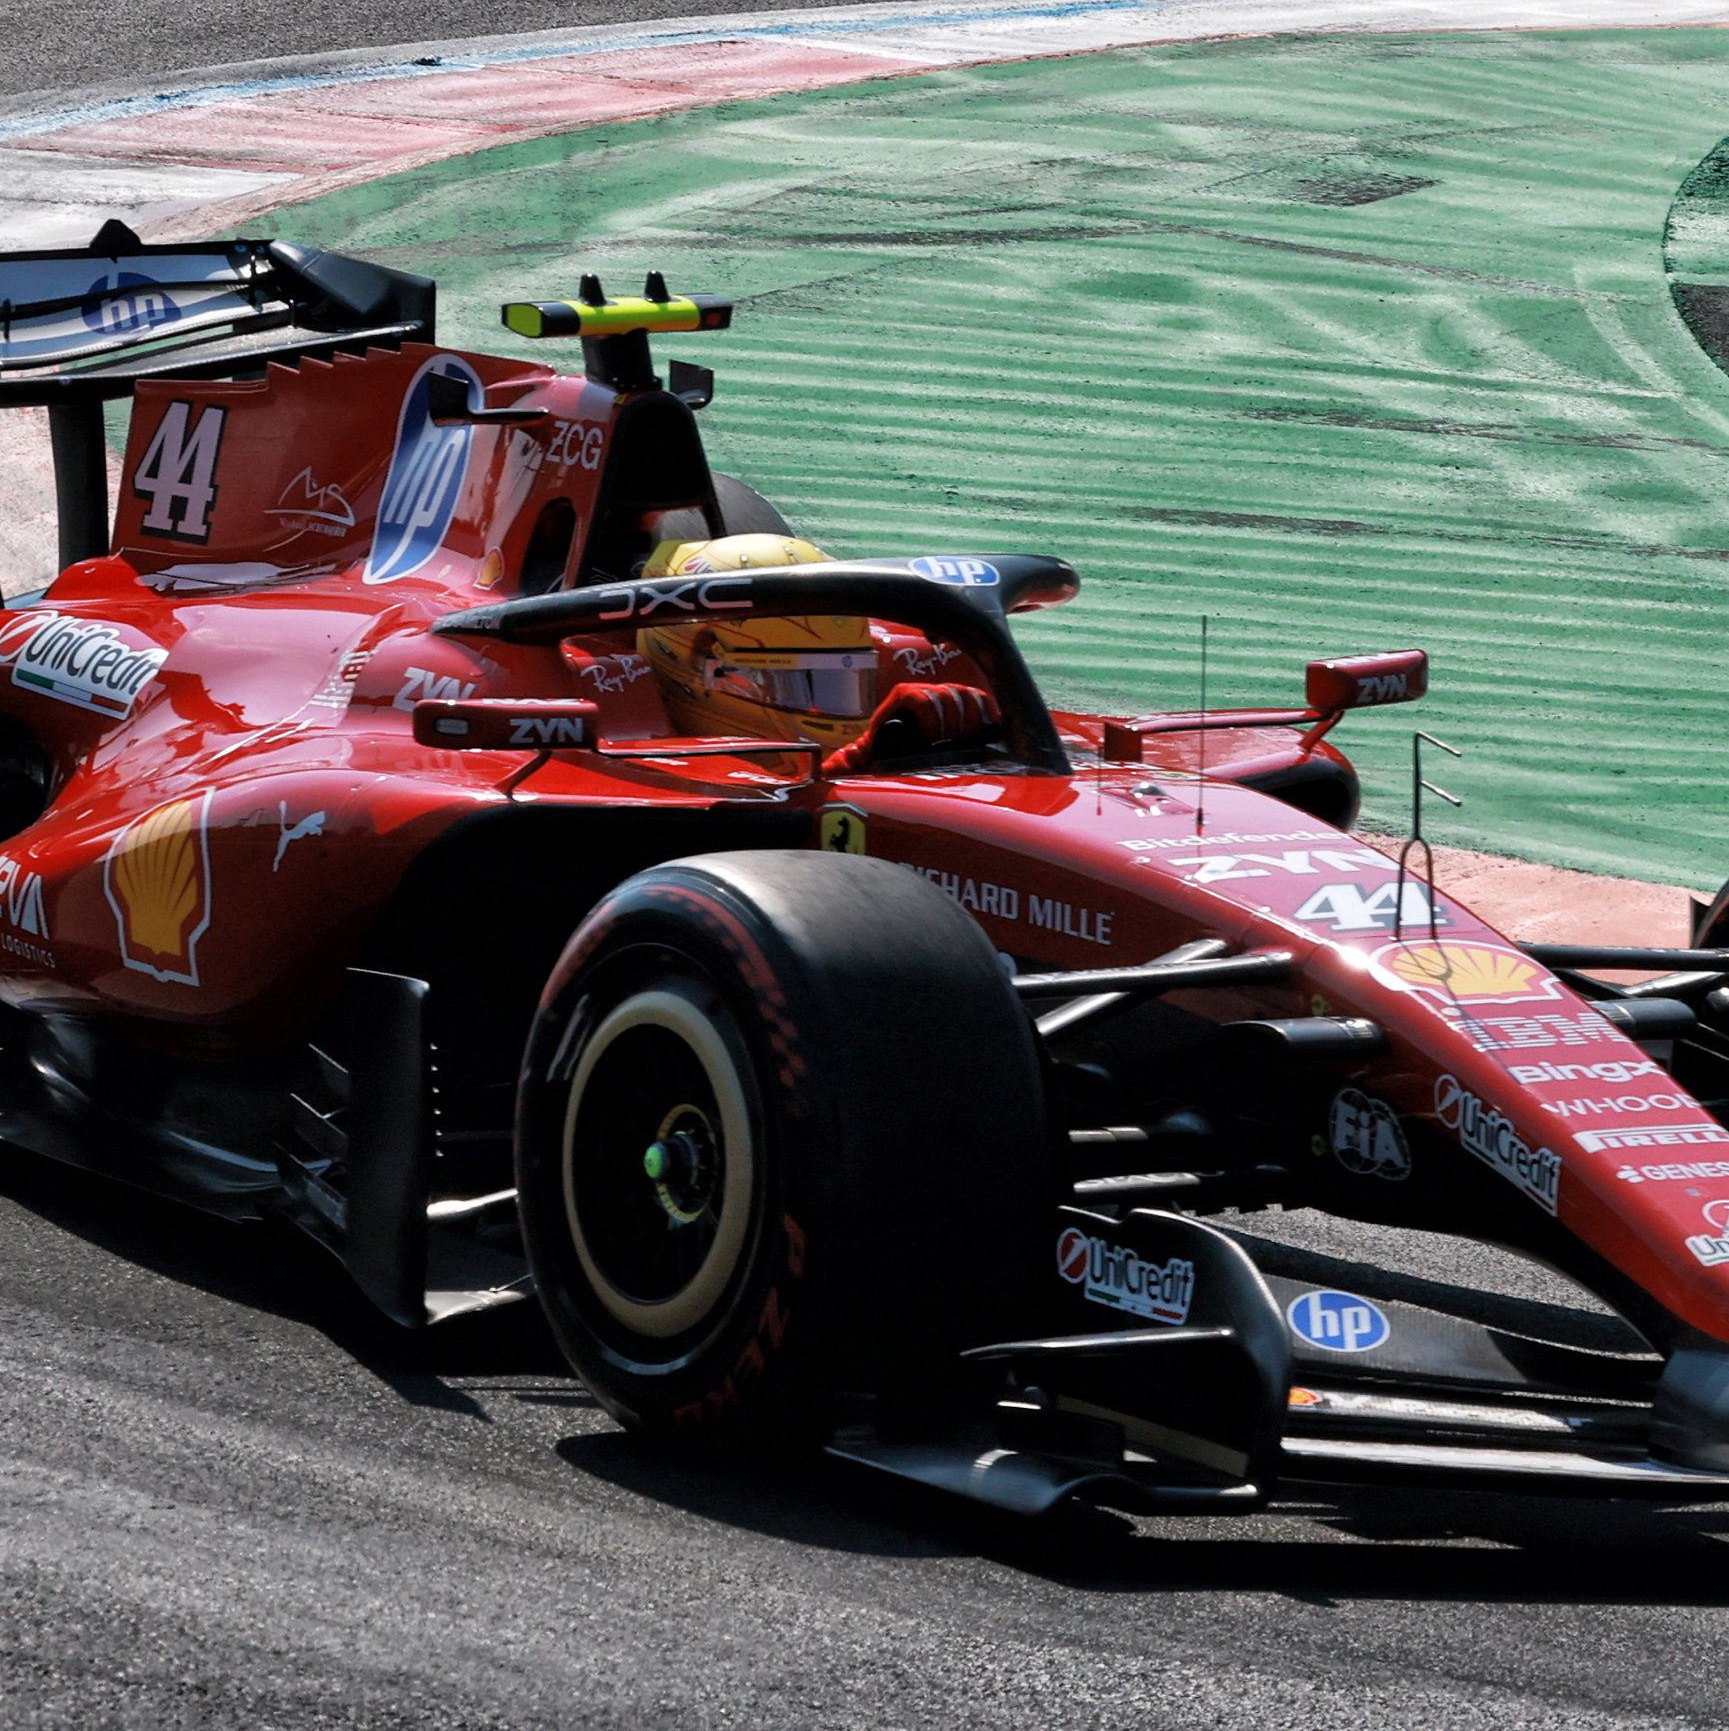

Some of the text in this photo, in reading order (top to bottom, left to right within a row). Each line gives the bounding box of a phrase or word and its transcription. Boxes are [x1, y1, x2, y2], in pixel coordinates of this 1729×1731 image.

[545, 420, 603, 470] ZCG
[132, 398, 227, 545] 44
[927, 555, 985, 586] hp
[597, 578, 755, 620] DXC
[30, 613, 158, 697] UniCredit
[891, 639, 963, 677] Ray-Ban
[393, 666, 481, 713] ZYN
[1356, 677, 1407, 704] ZYN
[508, 717, 584, 744] ZYN
[1115, 829, 1352, 852] Bitdefender
[1168, 849, 1400, 884] ZYN
[897, 862, 1111, 947] ICHARD MILLE
[1293, 880, 1456, 933] 44
[0, 933, 57, 970] LOGISTICS
[1447, 1011, 1635, 1053] IBM
[1540, 1092, 1702, 1118] WHOOP
[1462, 1093, 1562, 1204] UniCredit
[1086, 1239, 1194, 1310] UniCredit
[1310, 1298, 1373, 1351] hp
